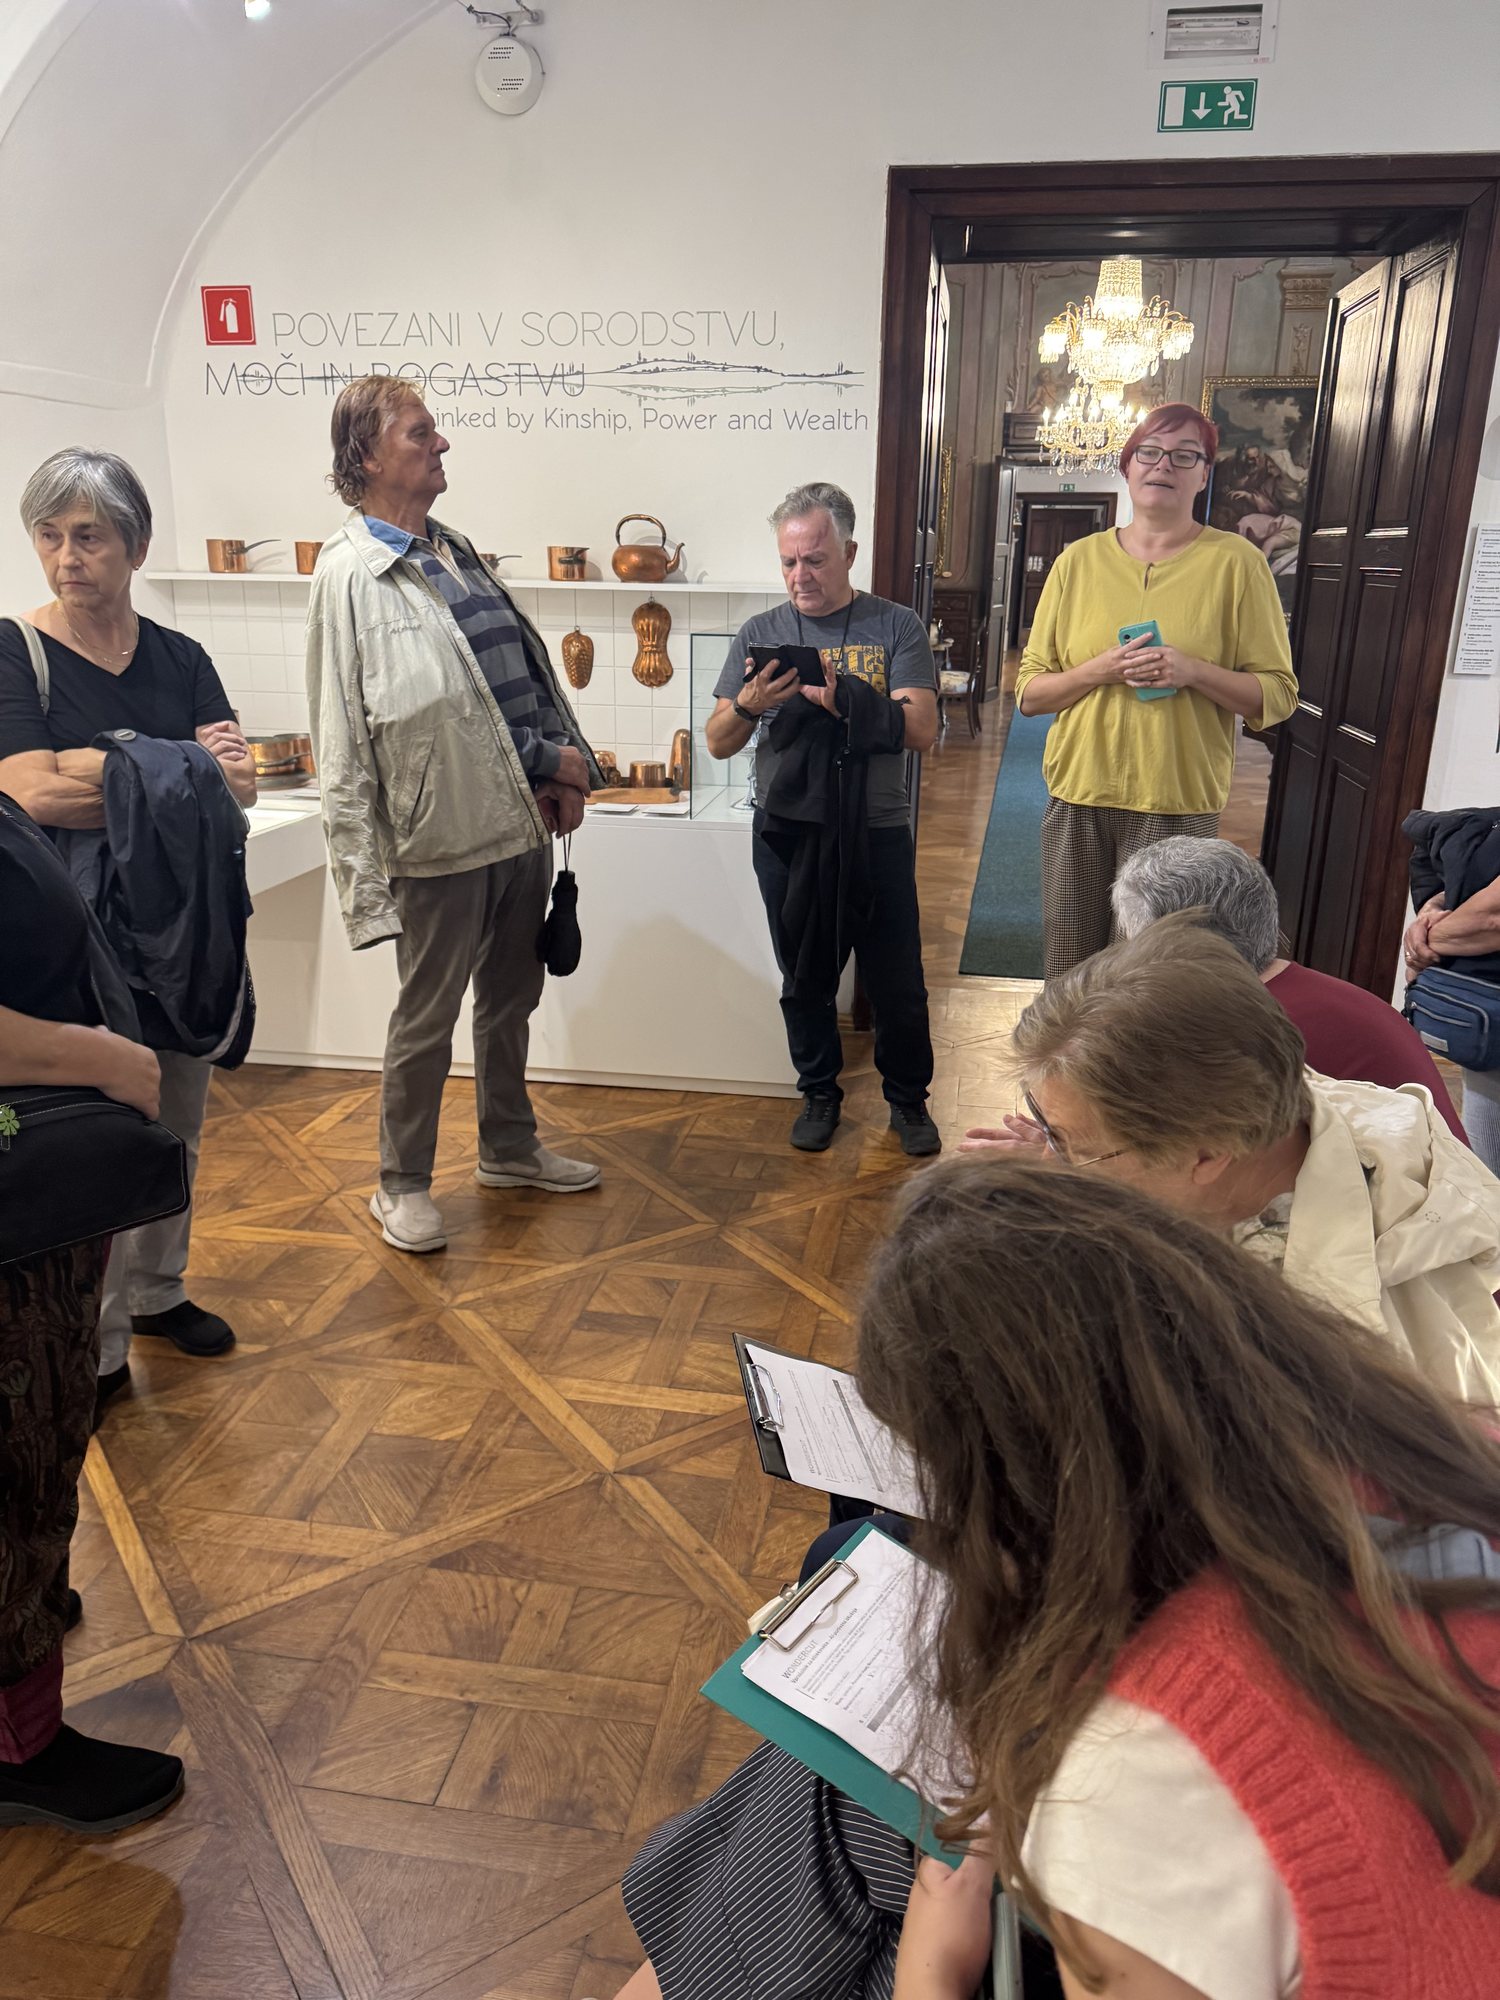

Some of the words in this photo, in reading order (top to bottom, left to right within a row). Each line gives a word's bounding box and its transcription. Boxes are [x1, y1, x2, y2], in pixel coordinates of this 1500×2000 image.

[272, 312, 461, 347] POVEZANI
[478, 312, 502, 347] V
[520, 310, 784, 350] SORODSTVU,
[436, 407, 497, 428] inked
[506, 407, 534, 434] by
[544, 407, 632, 434] Kinship,
[643, 408, 717, 430] Power
[727, 408, 772, 430] and
[783, 408, 868, 430] Wealth
[781, 1639, 819, 1679] WONDERCUT
